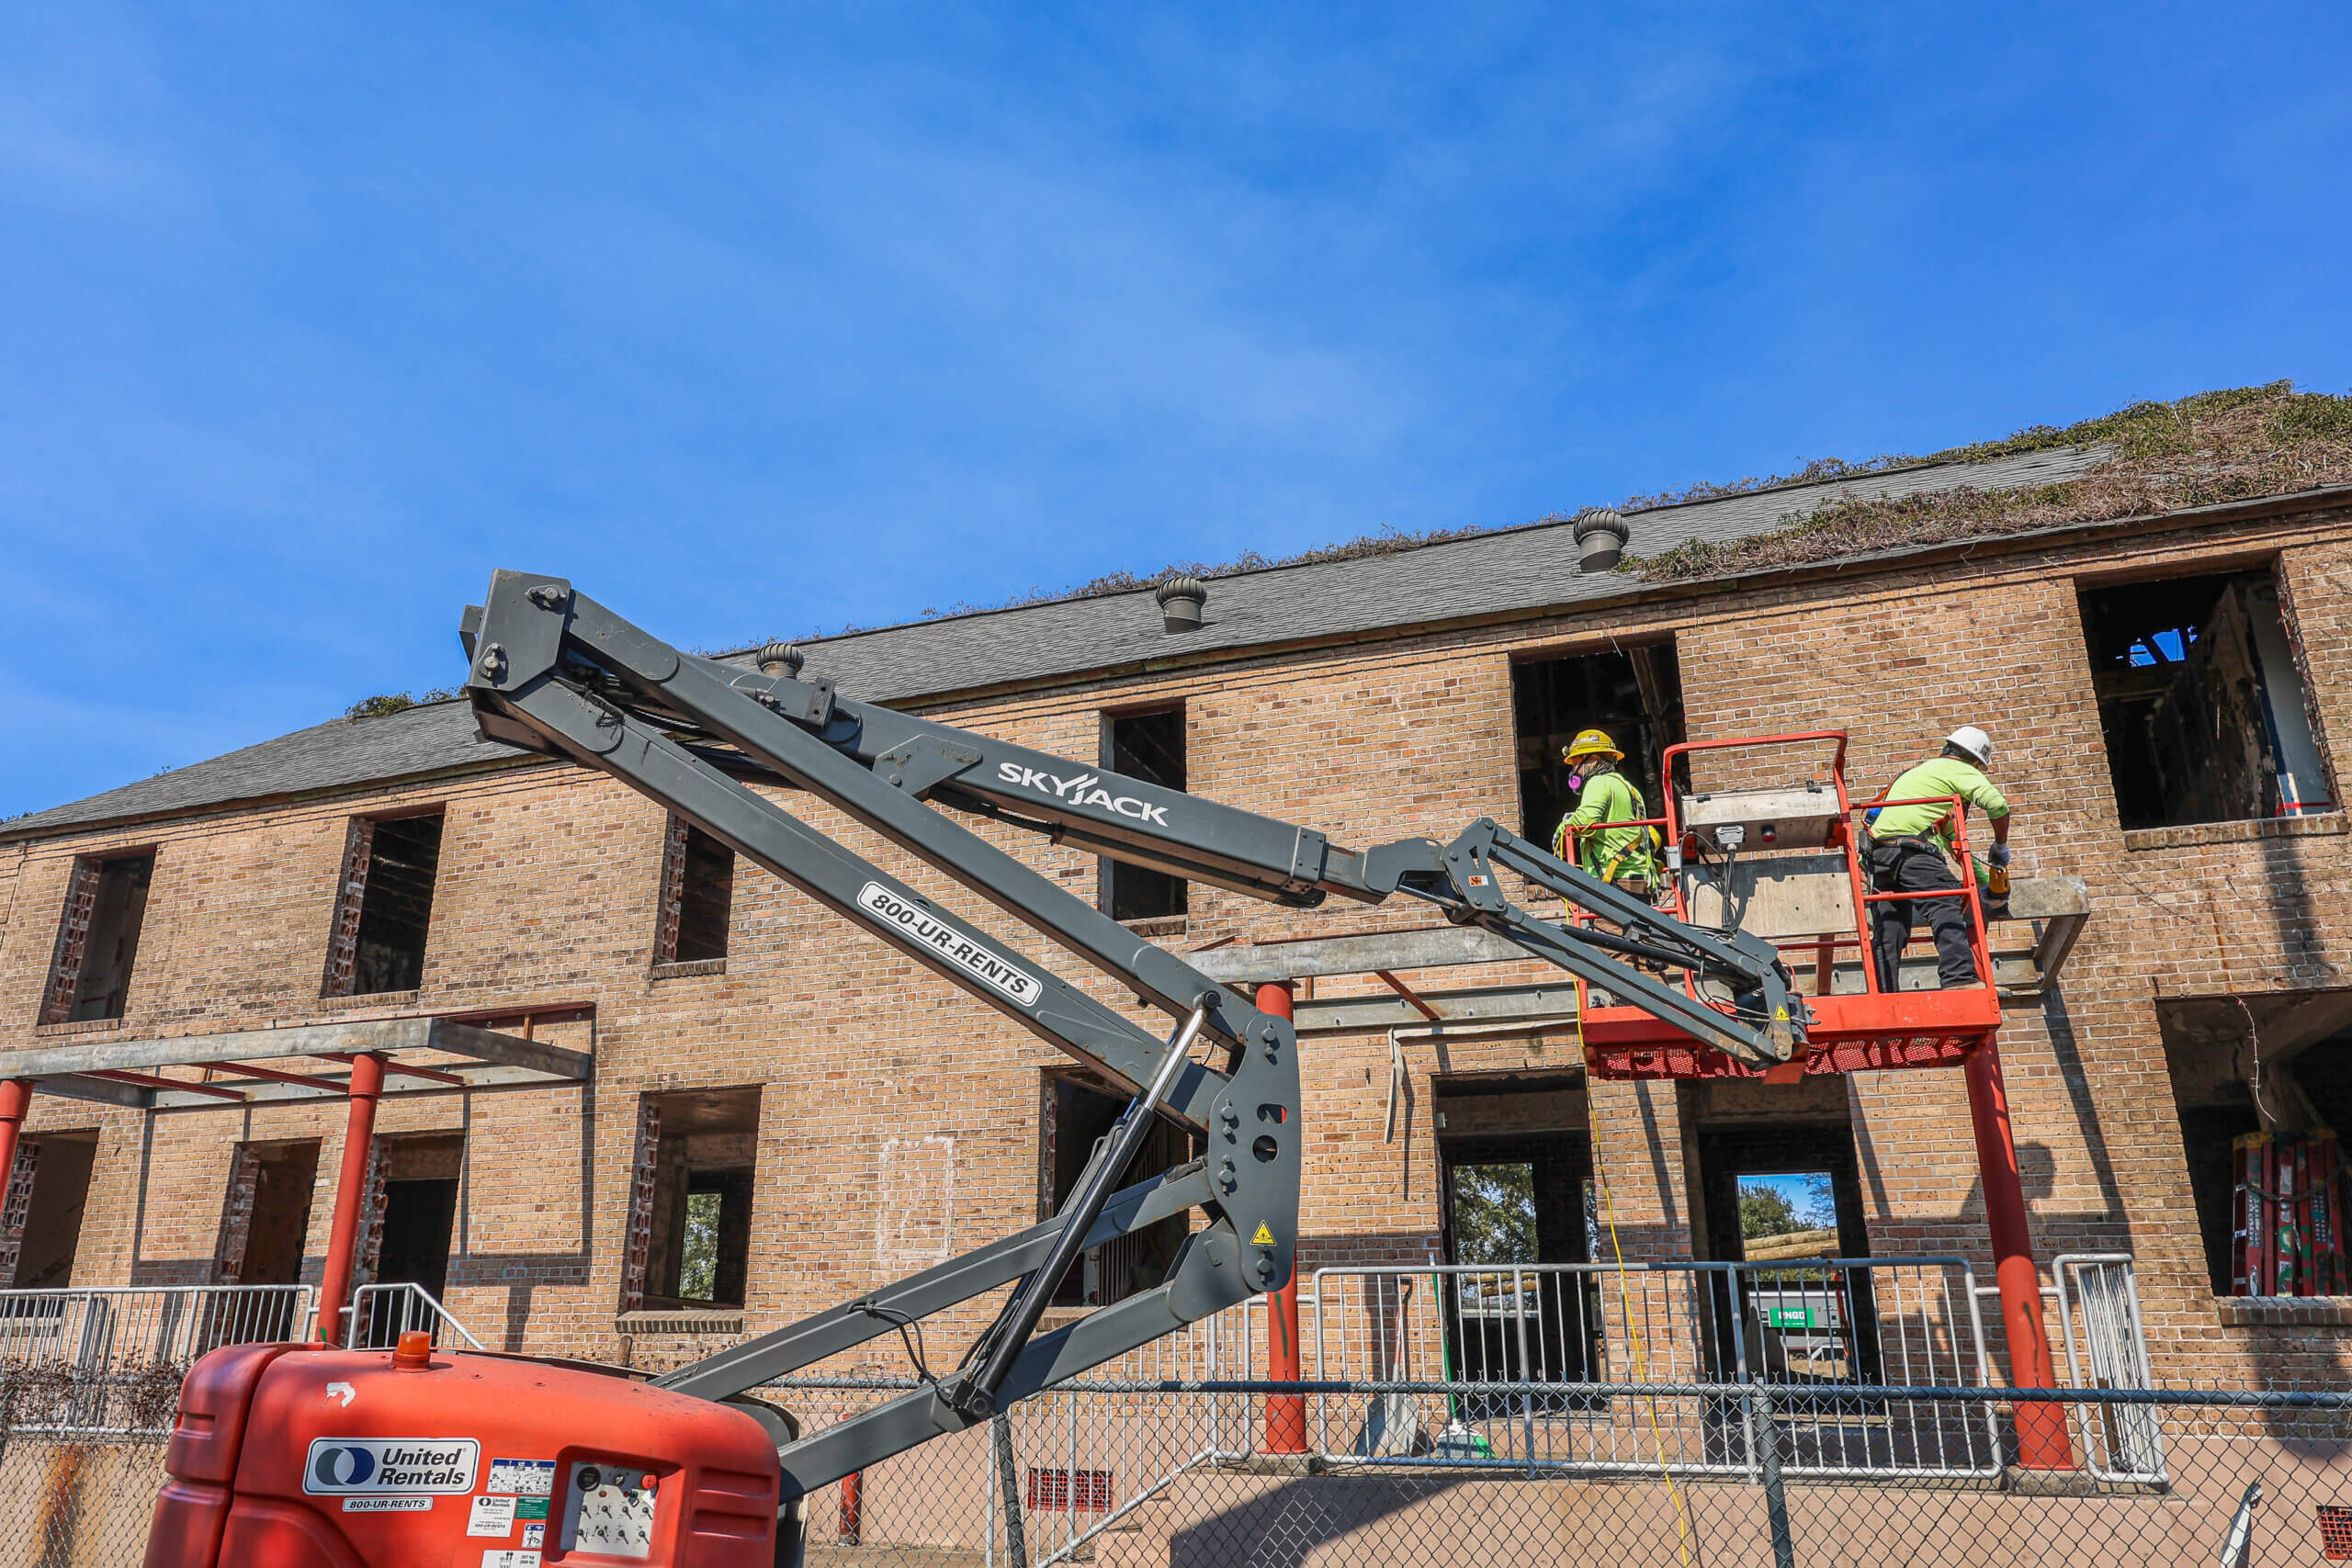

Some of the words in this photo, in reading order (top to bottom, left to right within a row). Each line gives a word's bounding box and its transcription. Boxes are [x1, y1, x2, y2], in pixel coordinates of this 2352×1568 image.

[998, 762, 1169, 827] SKYJACK
[872, 895, 1029, 994] 800-UR-RENTS
[381, 1448, 463, 1466] United
[378, 1468, 465, 1485] Rentals
[349, 1499, 425, 1509] 800-UR-RENTS
